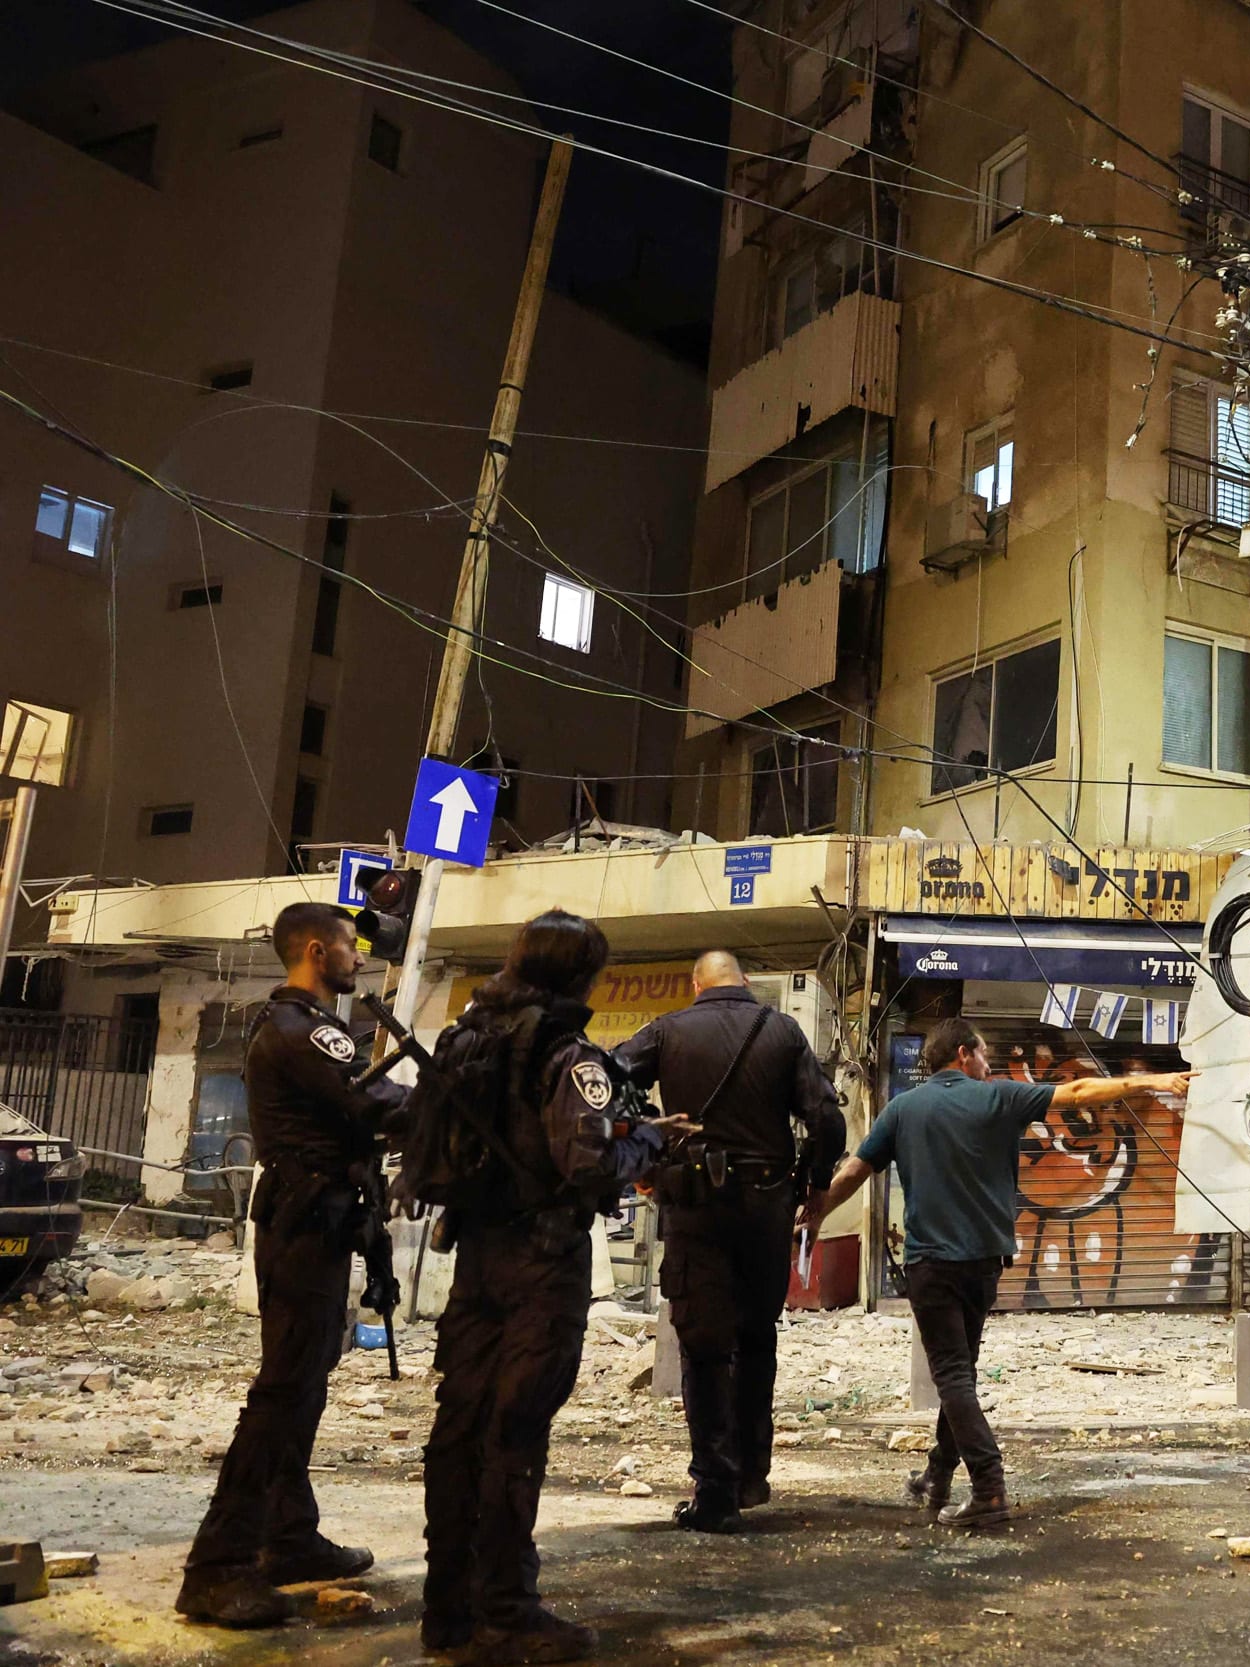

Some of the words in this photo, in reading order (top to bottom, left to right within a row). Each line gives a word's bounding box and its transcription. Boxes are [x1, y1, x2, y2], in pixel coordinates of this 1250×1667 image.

[733, 882, 751, 899] 12
[916, 957, 959, 973] Corona
[903, 1047, 919, 1056] SIM
